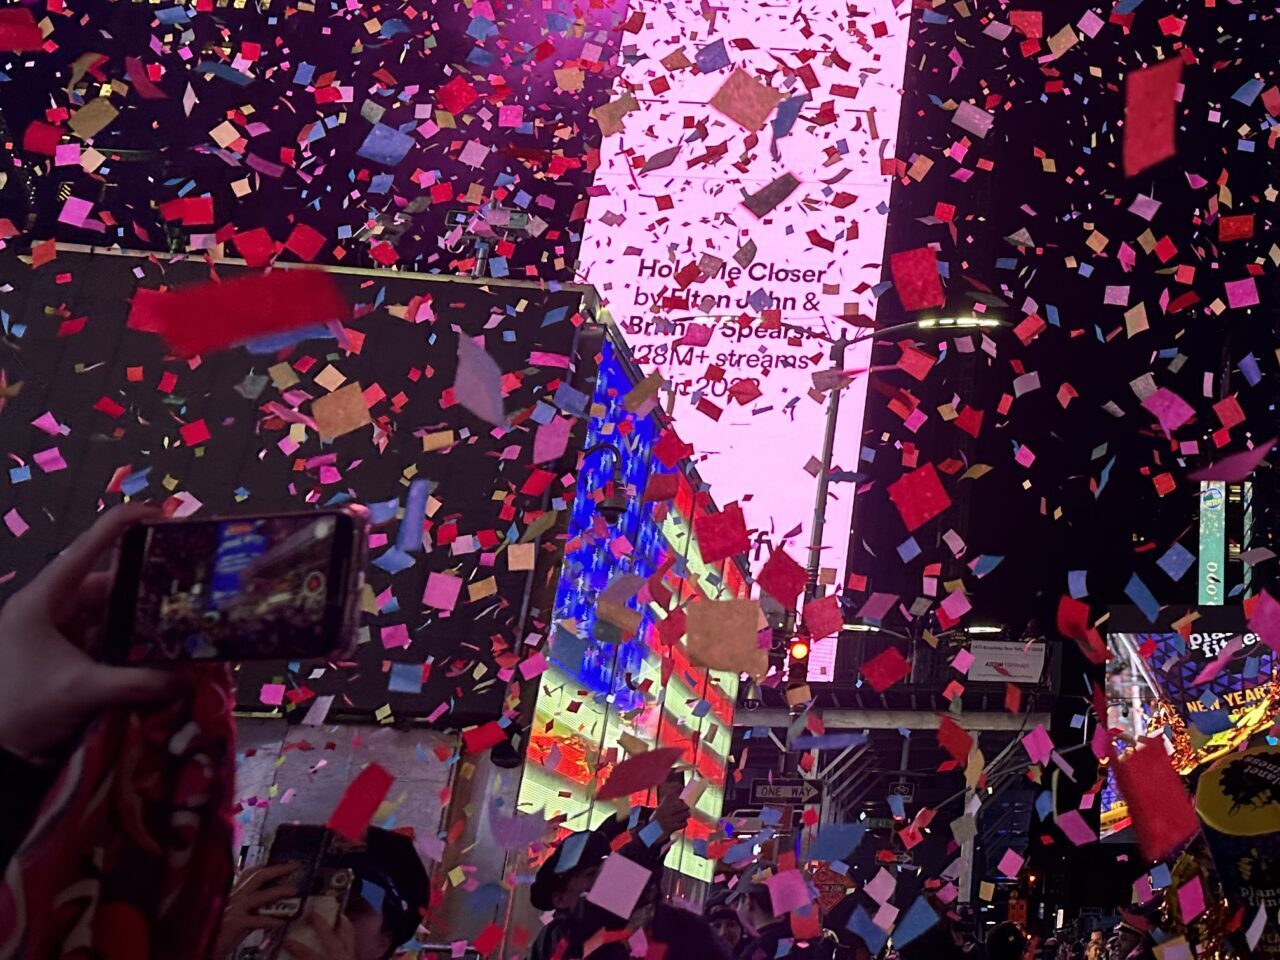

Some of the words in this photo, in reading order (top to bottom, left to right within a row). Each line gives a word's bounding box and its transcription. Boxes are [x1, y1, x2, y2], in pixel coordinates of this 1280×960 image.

[638, 259, 684, 279] Hol
[749, 262, 827, 283] Closer
[736, 291, 796, 311] Jhn
[802, 292, 820, 311] &
[715, 349, 809, 369] streams
[761, 787, 782, 797] ONE
[791, 787, 812, 797] WAY
